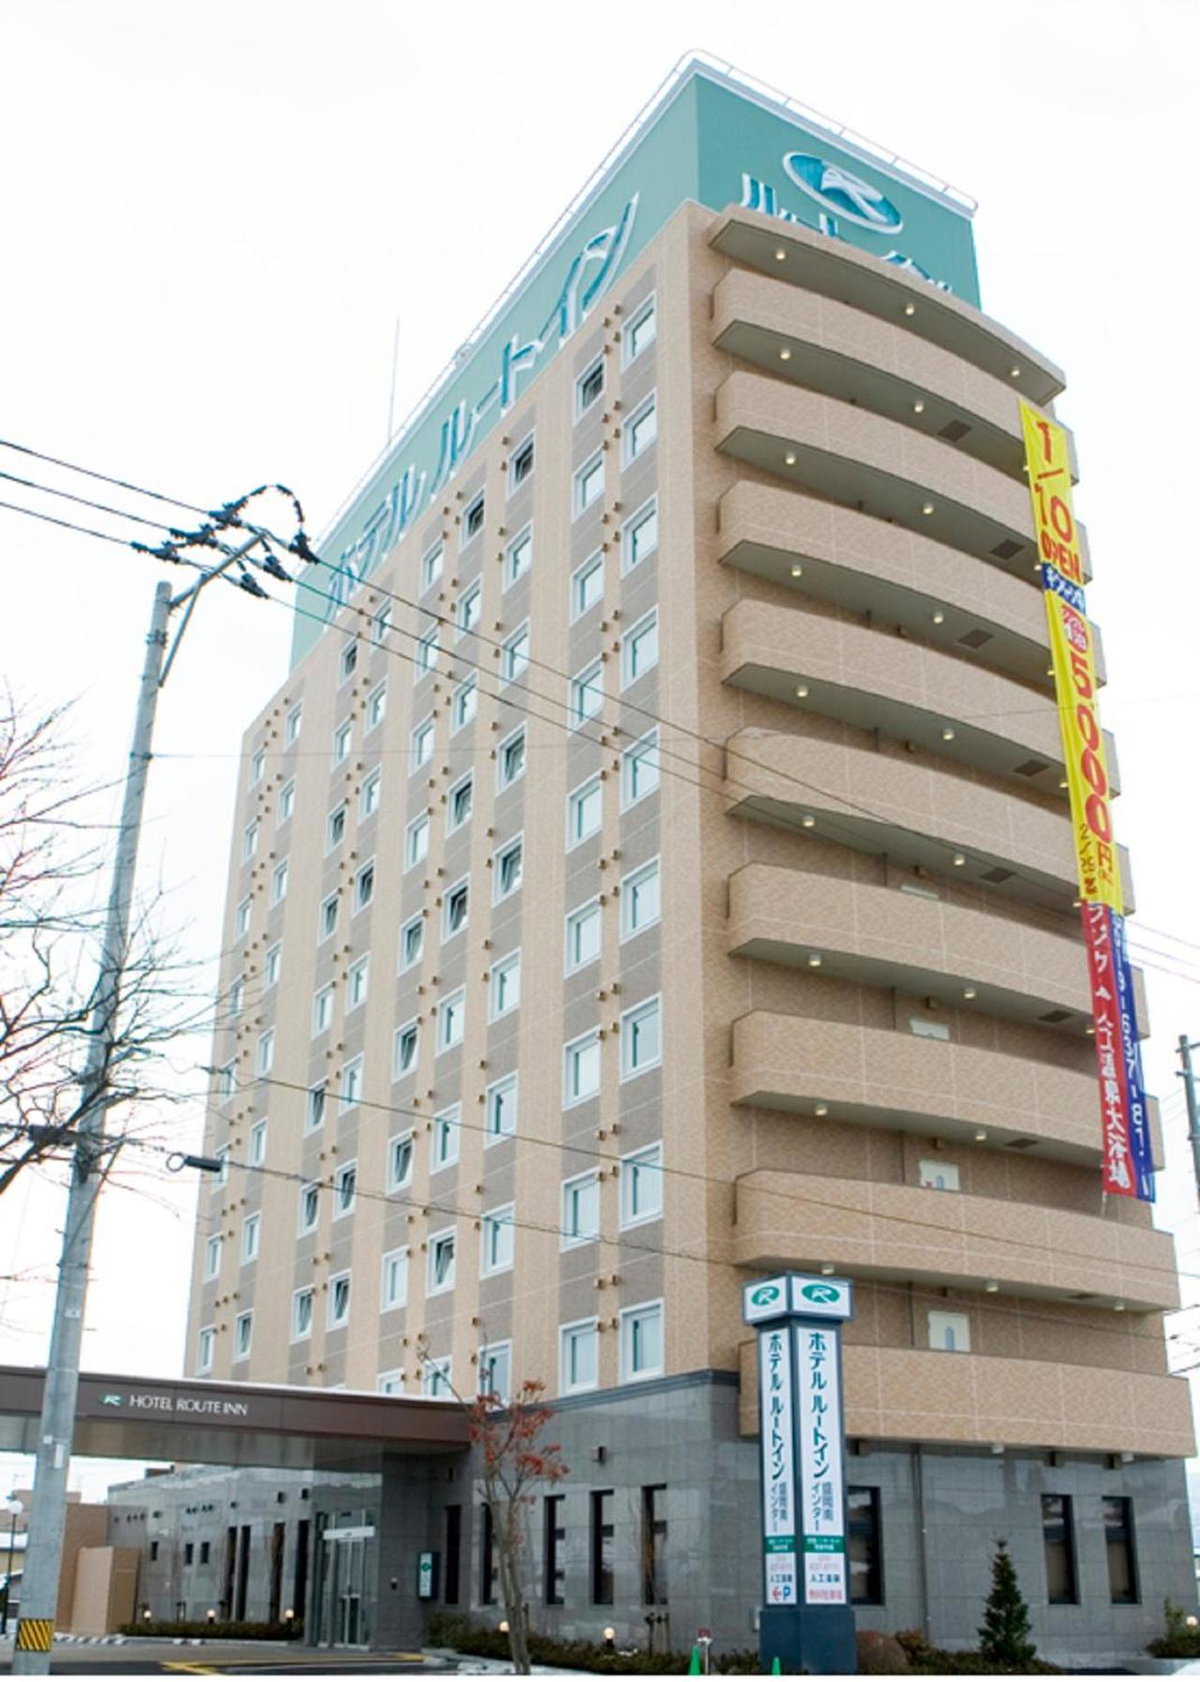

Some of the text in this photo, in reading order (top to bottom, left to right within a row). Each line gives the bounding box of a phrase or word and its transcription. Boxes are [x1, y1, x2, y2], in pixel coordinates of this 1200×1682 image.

[1040, 530, 1082, 584] OPEN
[129, 1394, 173, 1411] HOTEL
[176, 1397, 221, 1414] ROUTE
[223, 1402, 248, 1416] INN
